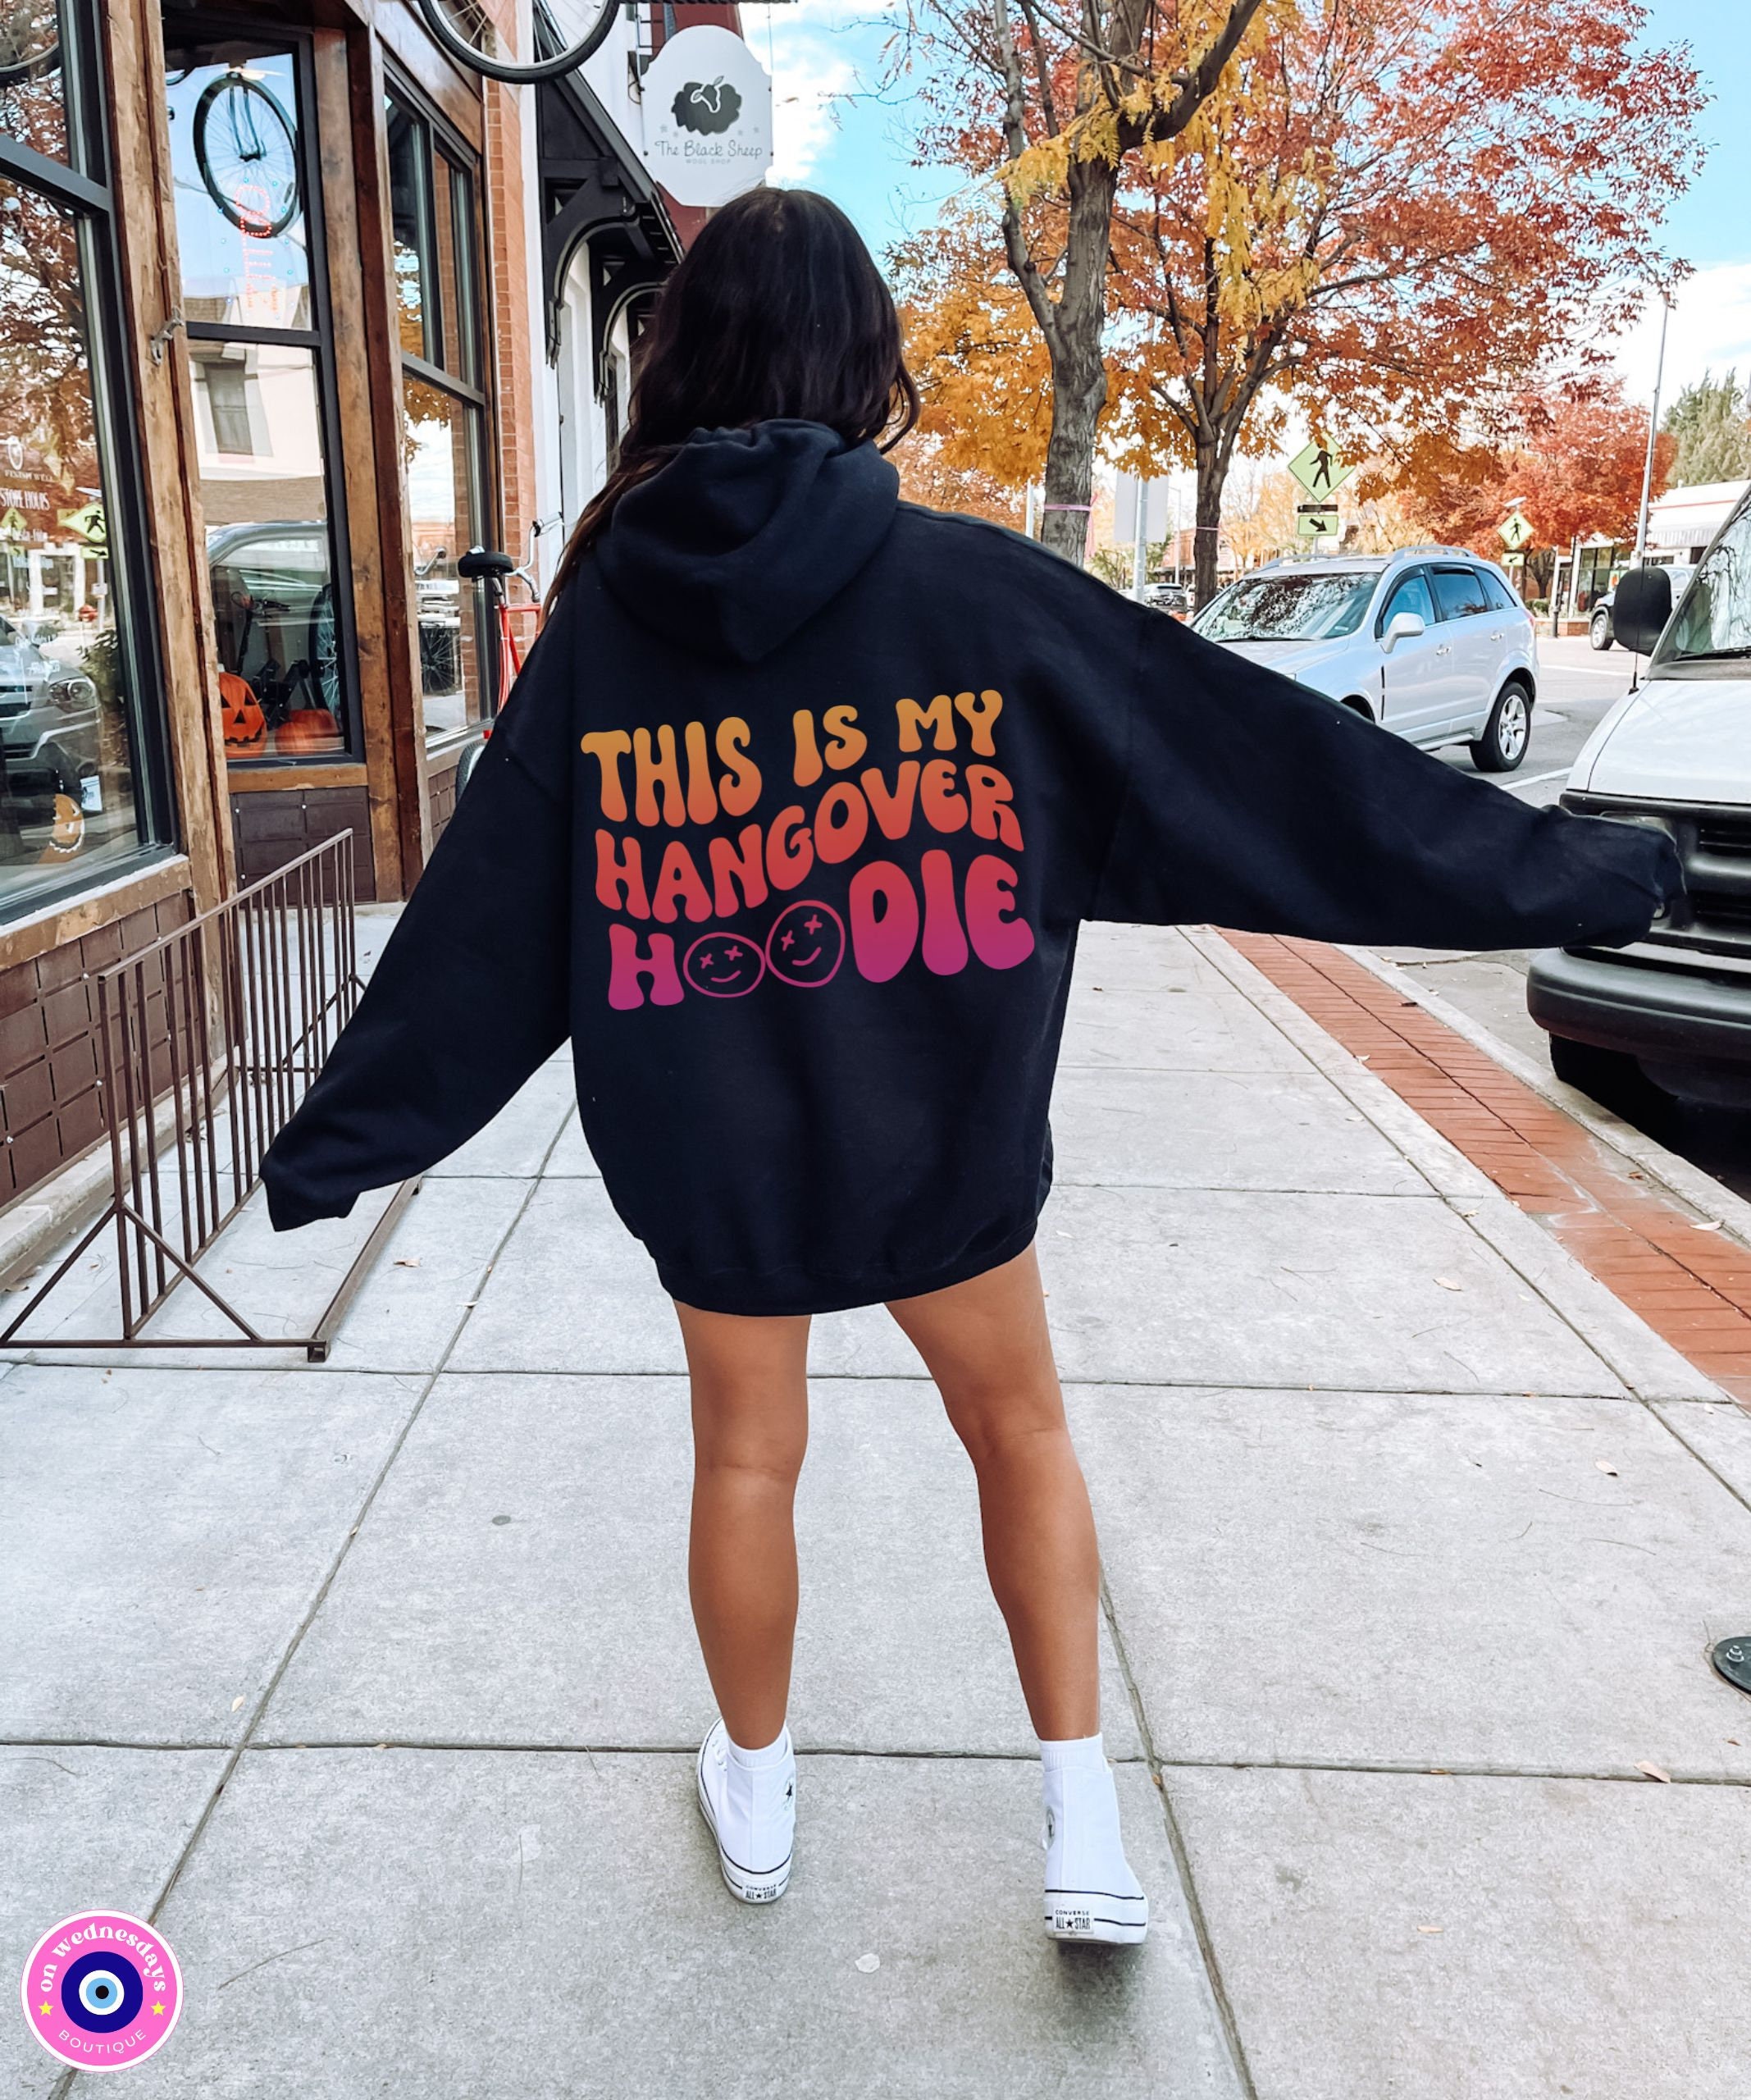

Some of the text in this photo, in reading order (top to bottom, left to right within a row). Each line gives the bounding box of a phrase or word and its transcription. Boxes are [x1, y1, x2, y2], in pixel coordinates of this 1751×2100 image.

[654, 139, 763, 160] The Black Sheep
[581, 689, 1003, 827] THIS IS MY
[595, 759, 1024, 924] HANGOVER
[608, 849, 1035, 1011] HOODIE
[1056, 1916, 1091, 1929] ALL STAR
